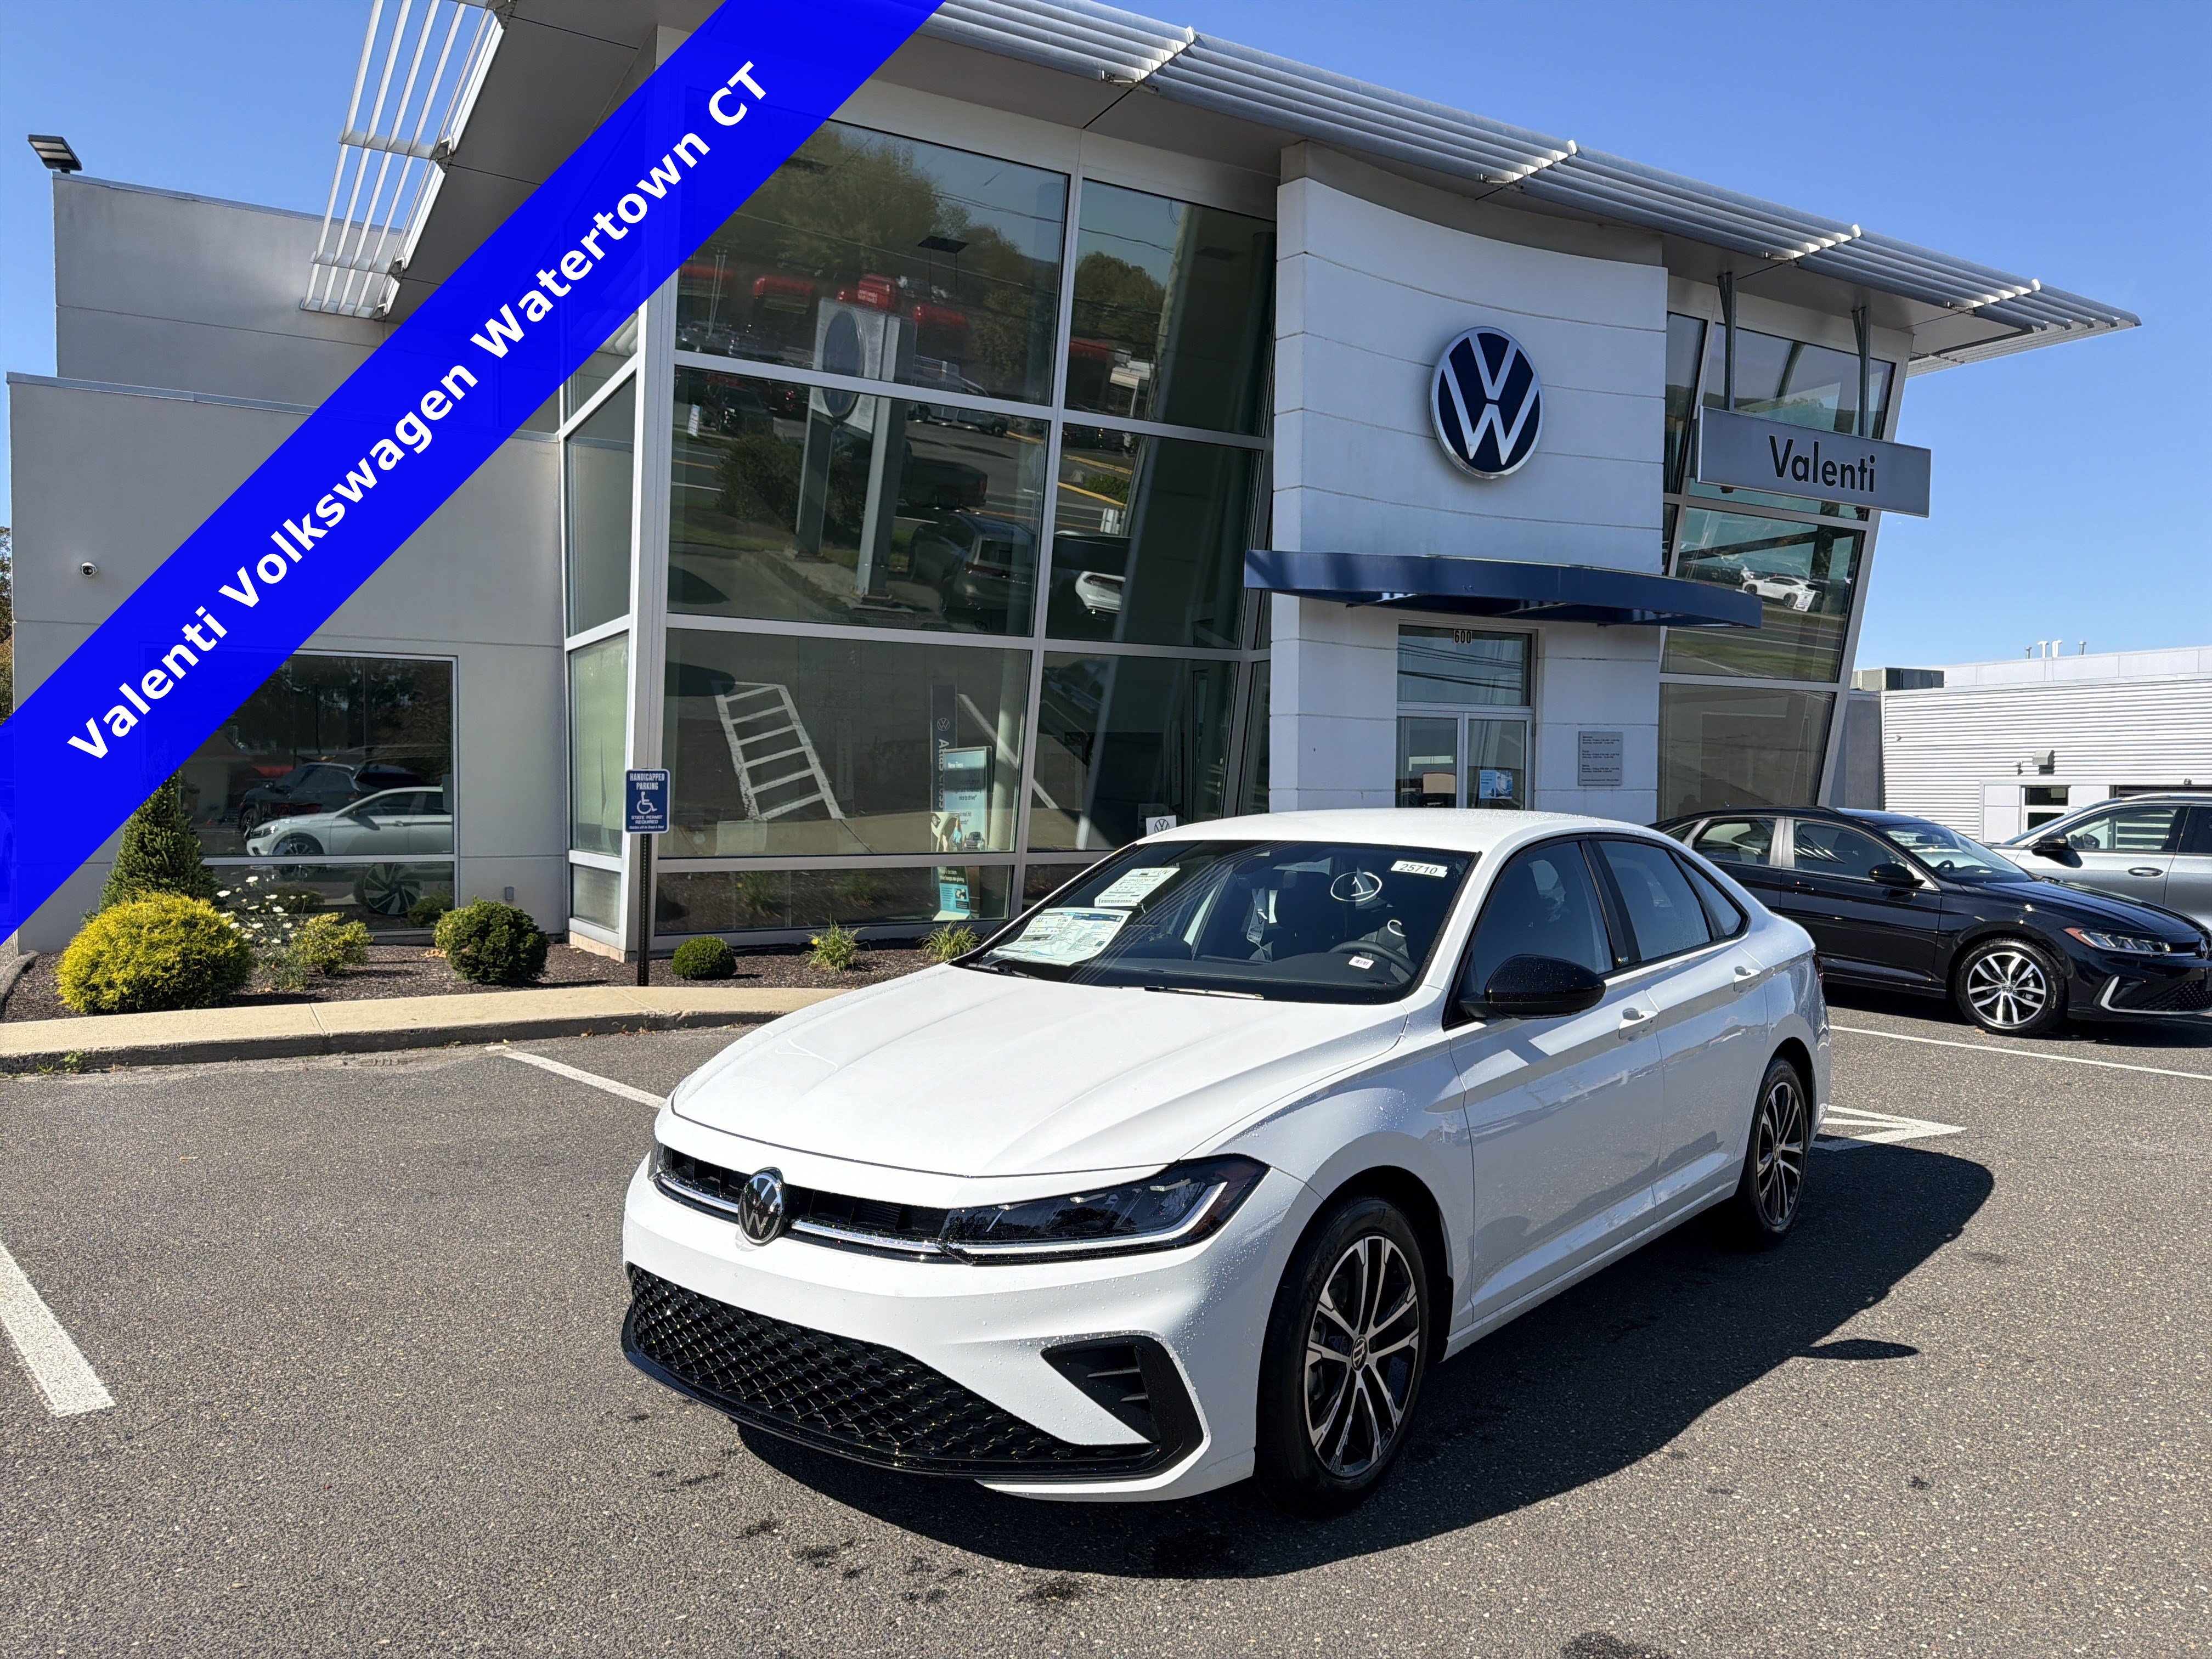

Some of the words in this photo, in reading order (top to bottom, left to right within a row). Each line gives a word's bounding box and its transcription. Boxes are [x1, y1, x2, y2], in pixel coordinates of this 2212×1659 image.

[1431, 326, 1544, 480] VW
[1769, 435, 1875, 493] Valenti
[1454, 630, 1471, 644] 600
[630, 773, 665, 781] HANDICAPPED
[1399, 864, 1438, 874] 25710
